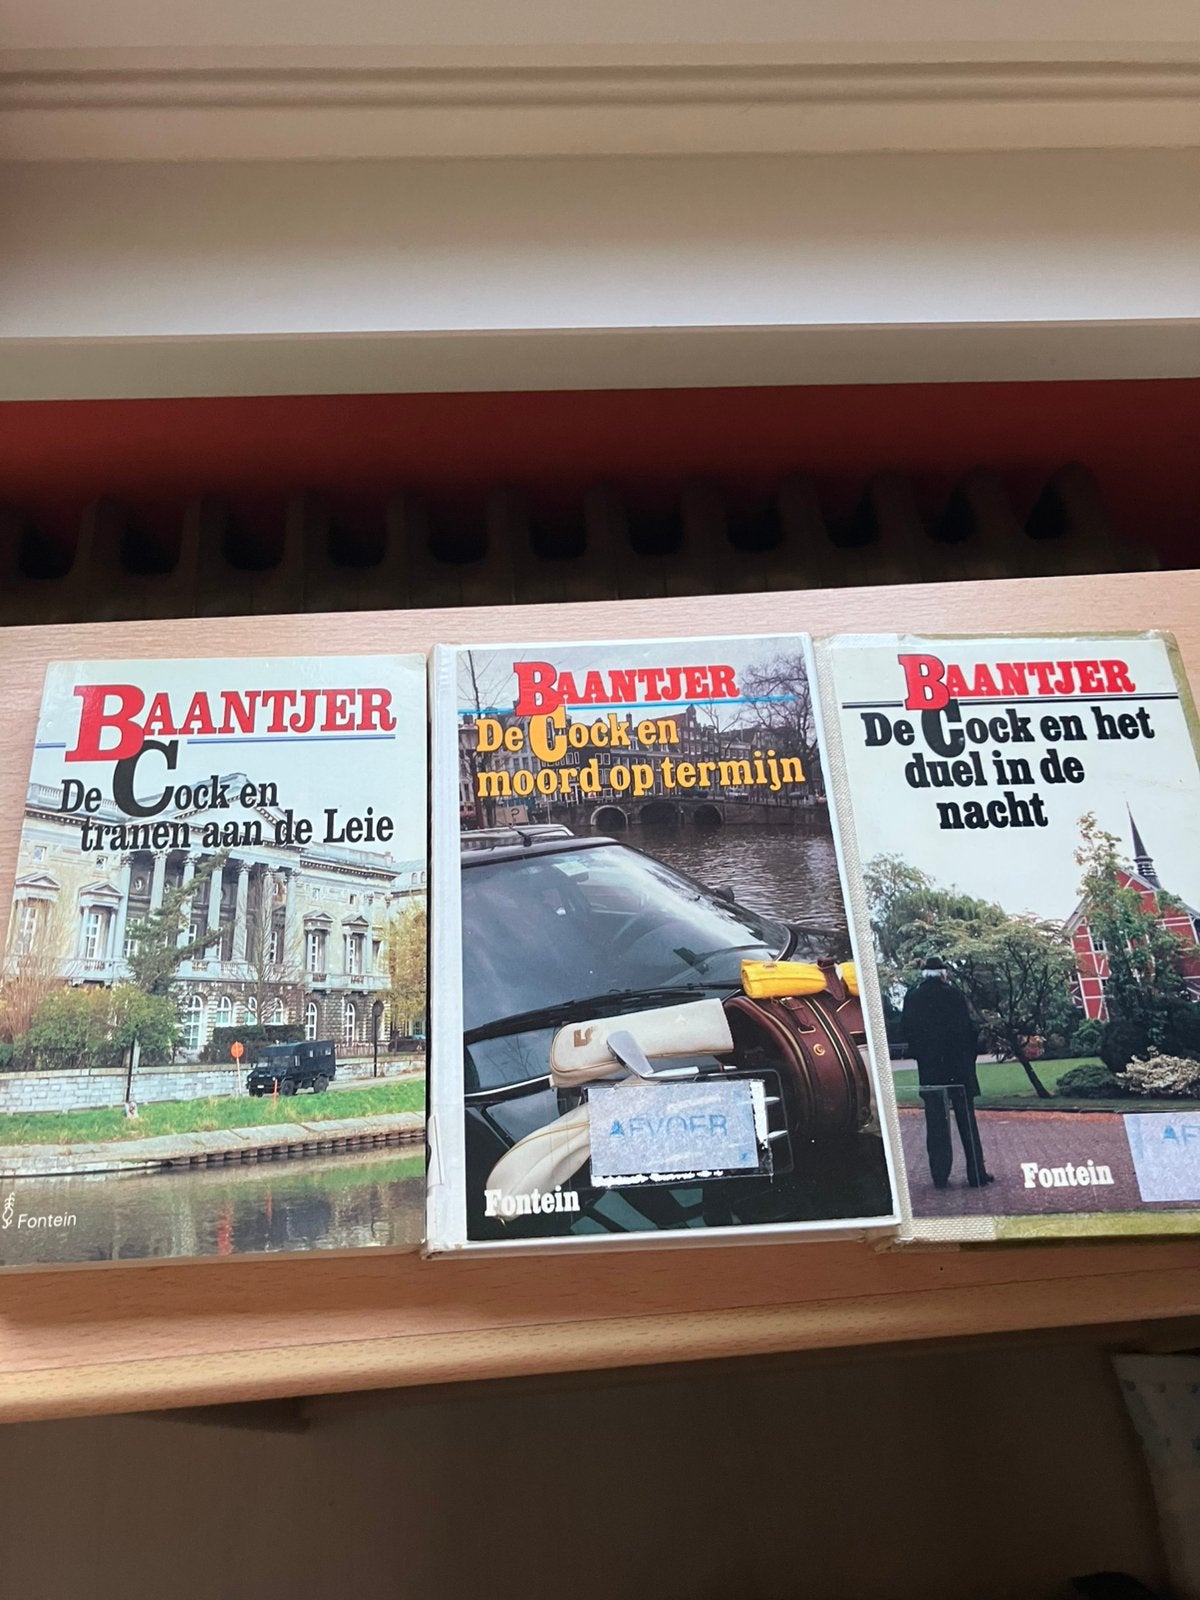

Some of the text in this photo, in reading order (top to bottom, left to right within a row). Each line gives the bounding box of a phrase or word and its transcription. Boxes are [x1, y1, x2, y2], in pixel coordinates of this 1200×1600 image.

[513, 661, 741, 717] BAANTJER
[897, 653, 1136, 711] BAANTJER
[65, 684, 397, 762] BAANTJER
[475, 706, 680, 763] De Cock en
[860, 698, 1155, 758] De Cock en het
[58, 739, 279, 818] De Cock en
[477, 749, 806, 798] moord op termijn
[904, 748, 1085, 788] duel in de
[81, 806, 394, 852] tranen aan de Leie
[936, 791, 1049, 830] nacht
[1020, 1159, 1115, 1189] Fontein
[17, 1211, 77, 1229] Fontein
[484, 1185, 581, 1216] Fontein
